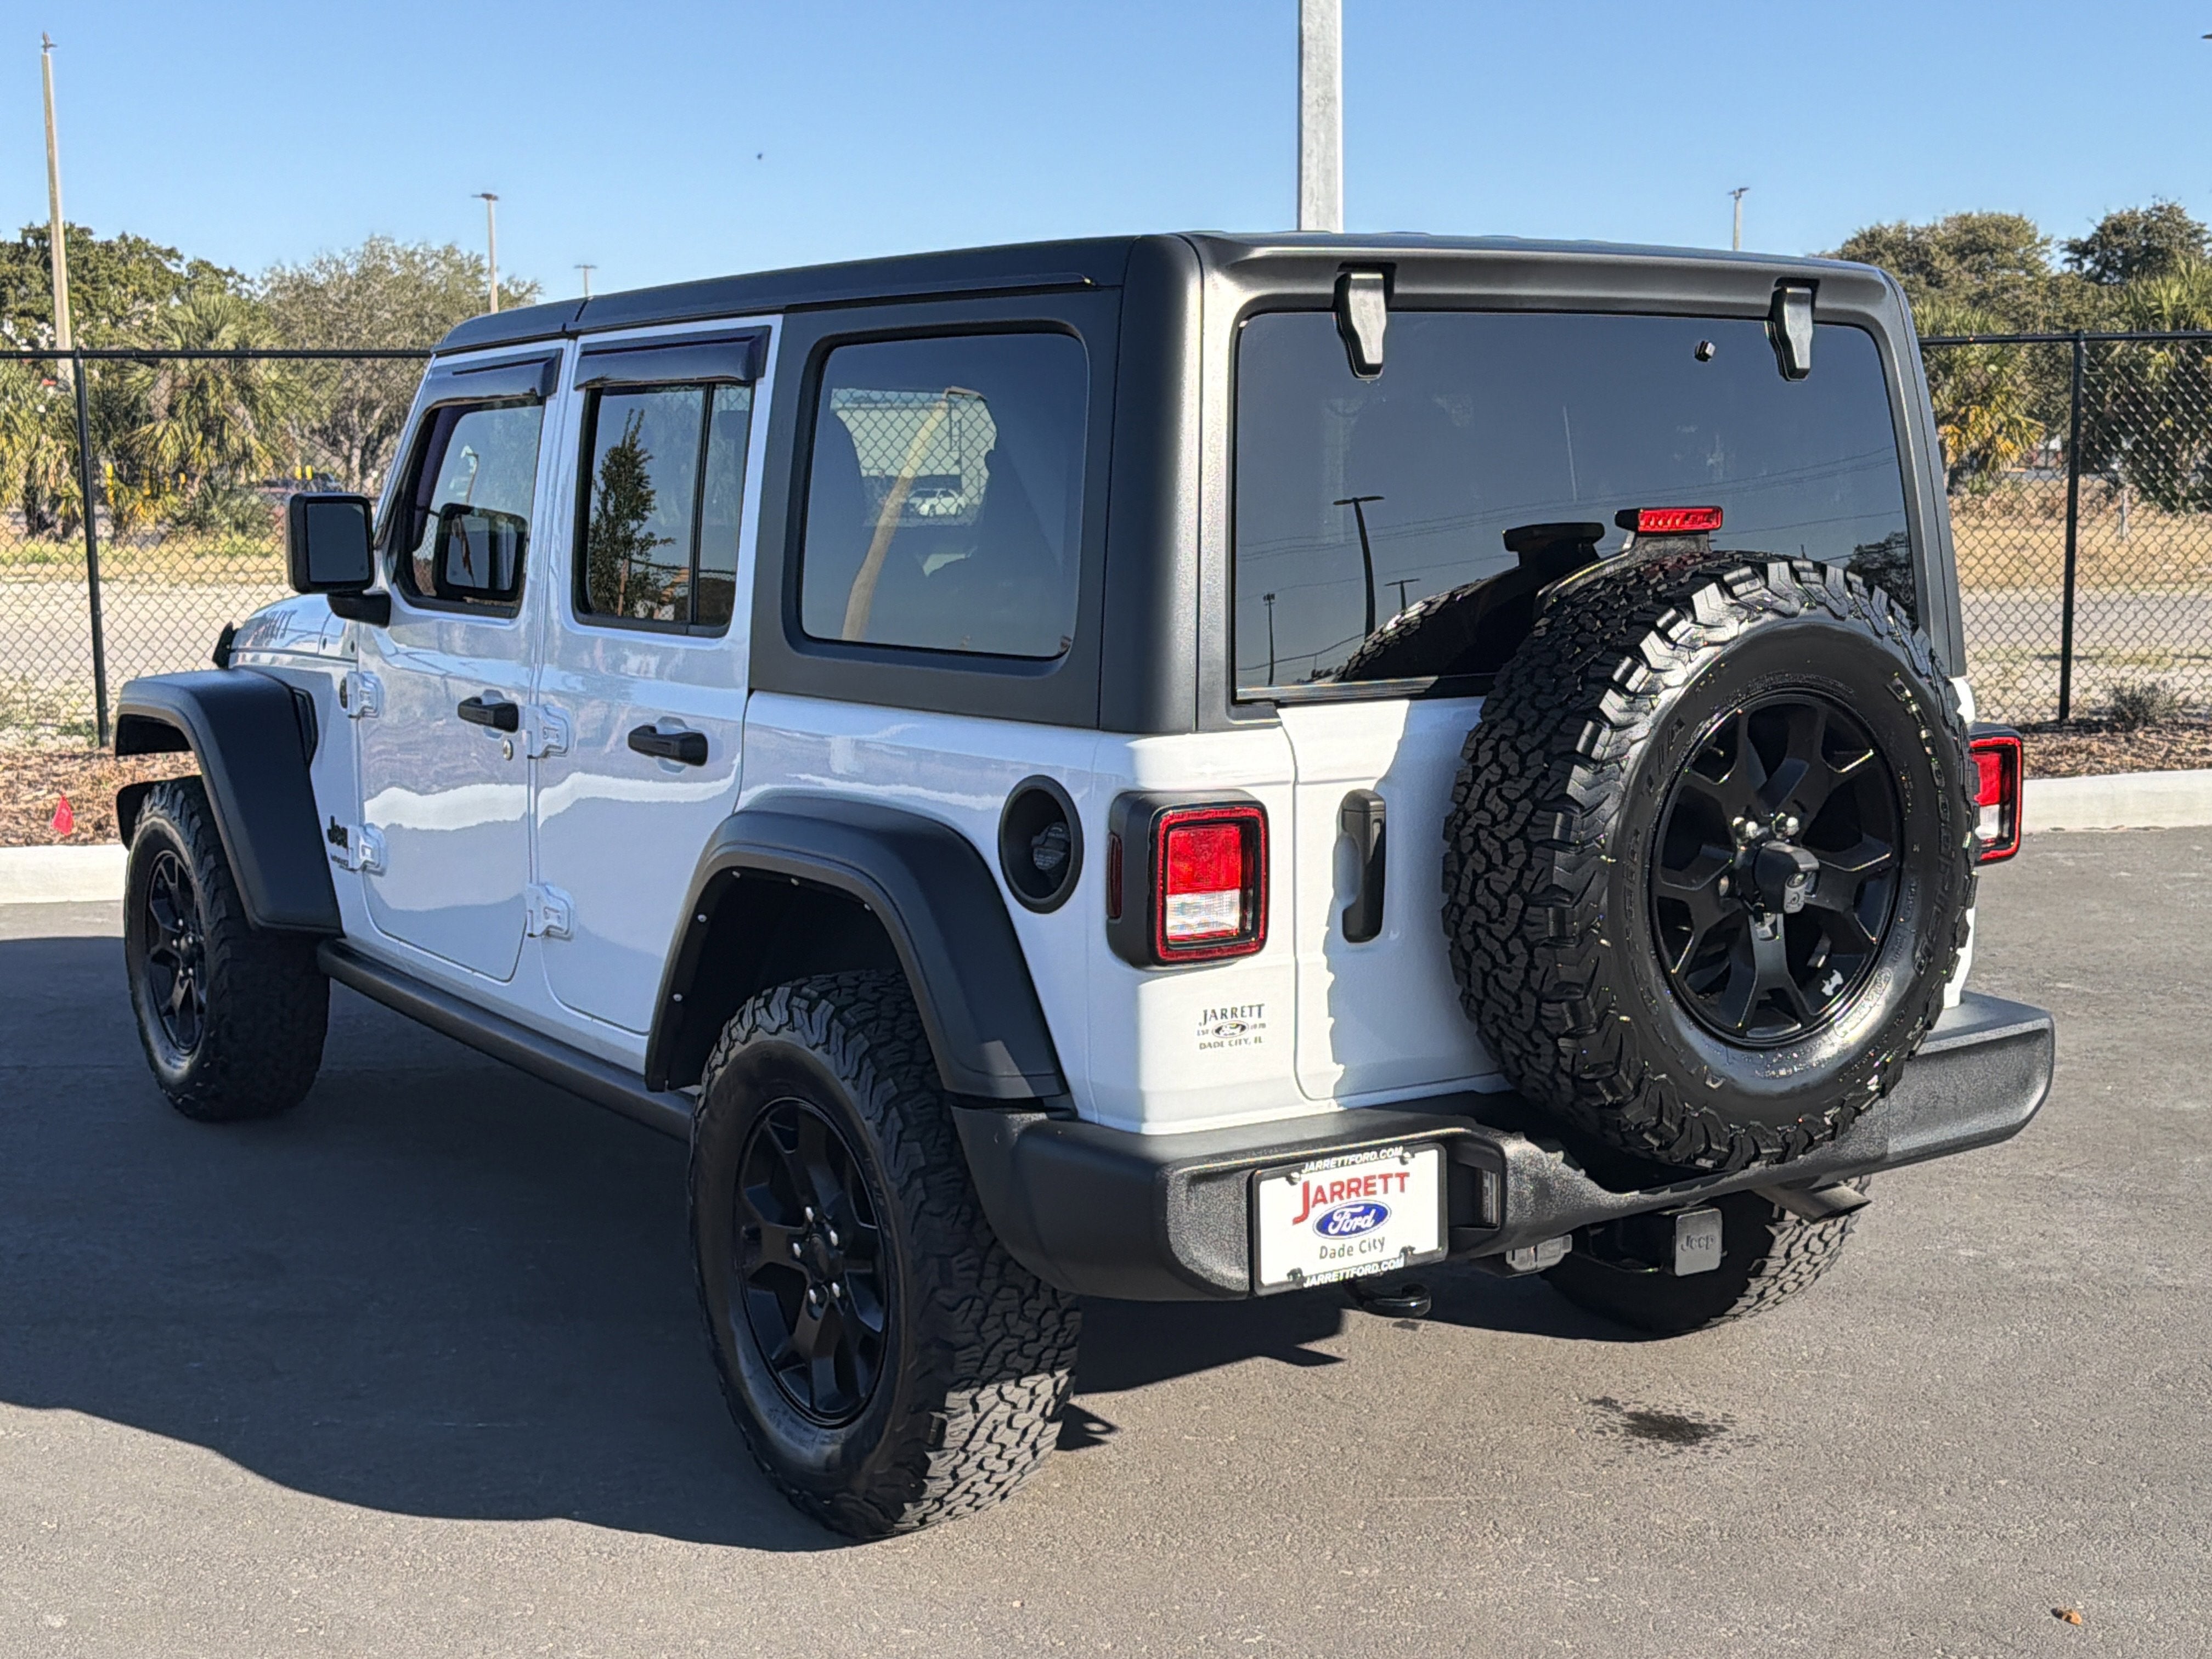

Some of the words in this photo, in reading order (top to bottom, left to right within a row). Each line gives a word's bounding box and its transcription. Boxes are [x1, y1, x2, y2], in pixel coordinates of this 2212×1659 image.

[1198, 1003, 1265, 1026] JARRETT
[1302, 1146, 1403, 1173] JARRETTFORD.COM
[1292, 1172, 1410, 1226] JARRETT
[1327, 1205, 1378, 1234] Ford
[1319, 1244, 1354, 1260] Dade
[1359, 1236, 1386, 1254] City
[1680, 1234, 1716, 1252] Jeep
[1303, 1256, 1404, 1288] JARRETTFORD.COM
